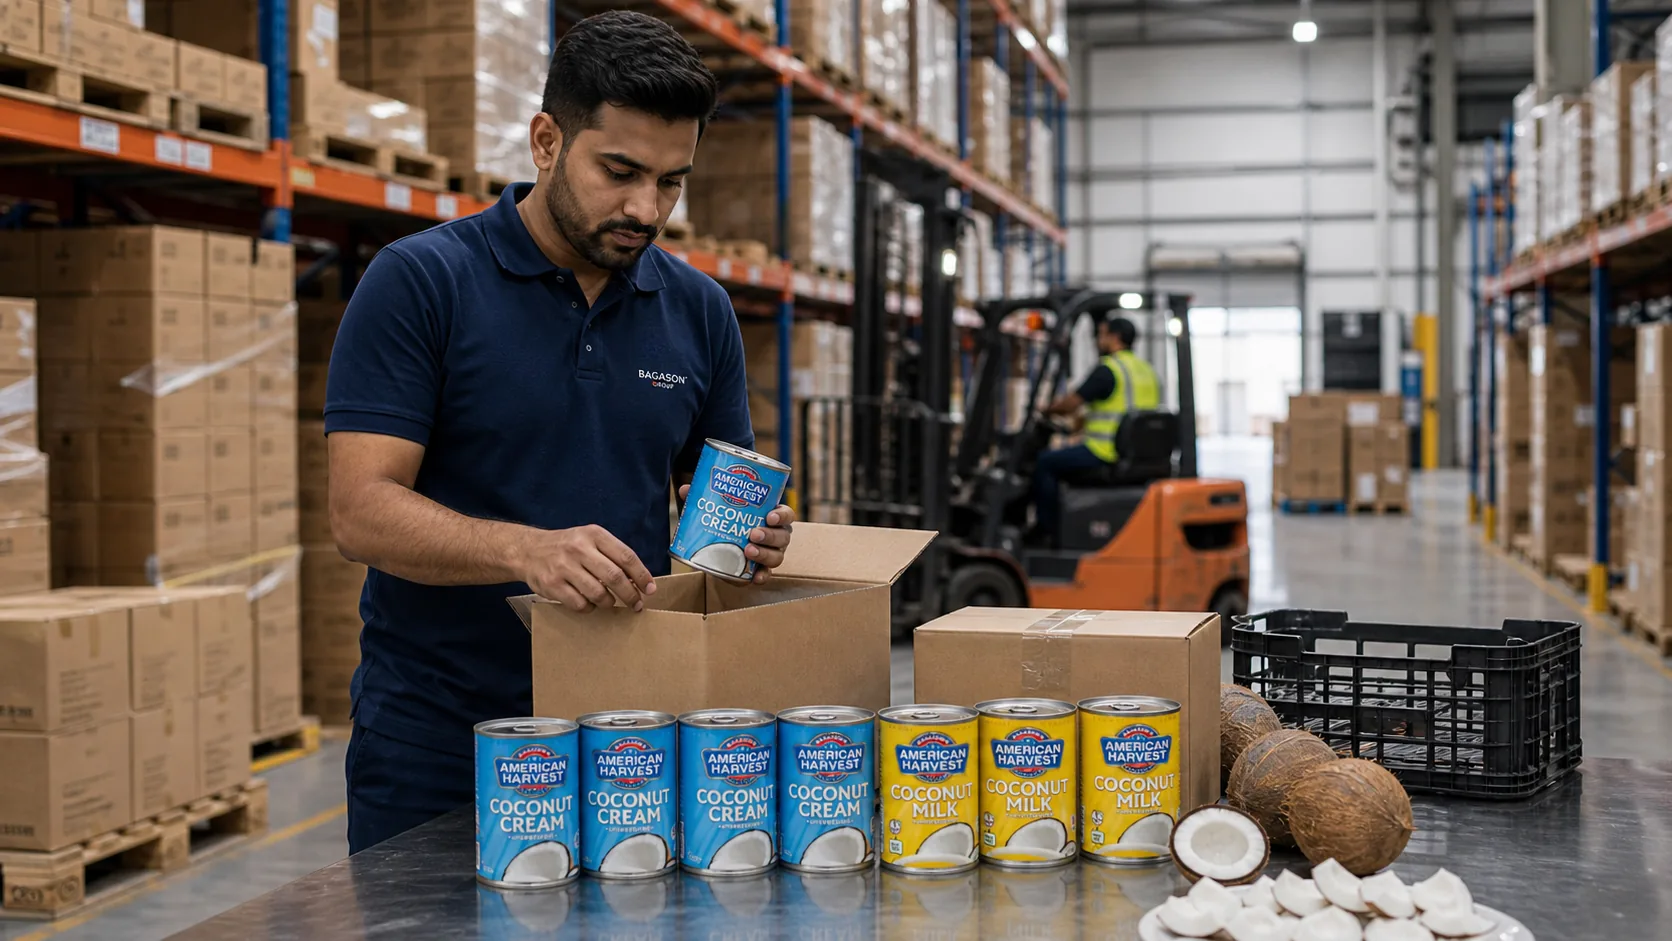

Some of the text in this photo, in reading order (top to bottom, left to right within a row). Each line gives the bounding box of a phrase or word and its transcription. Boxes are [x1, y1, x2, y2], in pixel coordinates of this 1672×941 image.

[638, 369, 685, 384] BAGASON
[713, 482, 762, 503] HARVEST
[714, 472, 768, 496] AMERICAN
[697, 498, 764, 527] COCONUT
[701, 513, 752, 540] CREAM
[798, 748, 863, 760] AMERICAN
[995, 744, 1061, 756] AMERICAN
[1105, 739, 1169, 752] AMERICAN
[597, 753, 663, 766] AMERICAN
[708, 750, 770, 764] AMERICAN
[900, 748, 966, 761] AMERICAN
[998, 754, 1058, 766] HARVEST
[1108, 750, 1167, 763] HARVEST
[500, 760, 566, 773] AMERICAN
[600, 764, 660, 777] HARVEST
[711, 761, 768, 775] HARVEST
[801, 758, 860, 771] HARVEST
[902, 759, 963, 772] HARVEST
[502, 771, 564, 784] HARVEST
[1094, 774, 1175, 793] COCONUT
[696, 784, 774, 805] COCONUT
[788, 782, 868, 801] COCONUT
[891, 783, 972, 802] COCONUT
[986, 778, 1068, 797] COCONUT
[490, 795, 573, 816] COCONUT
[588, 788, 670, 808] COCONUT
[1006, 796, 1052, 812] MILK
[1117, 792, 1161, 809] MILK
[597, 806, 661, 825] CREAM
[708, 803, 768, 822] CREAM
[799, 800, 860, 818] CREAM
[912, 801, 958, 818] MILK
[500, 814, 564, 833] CREAM
